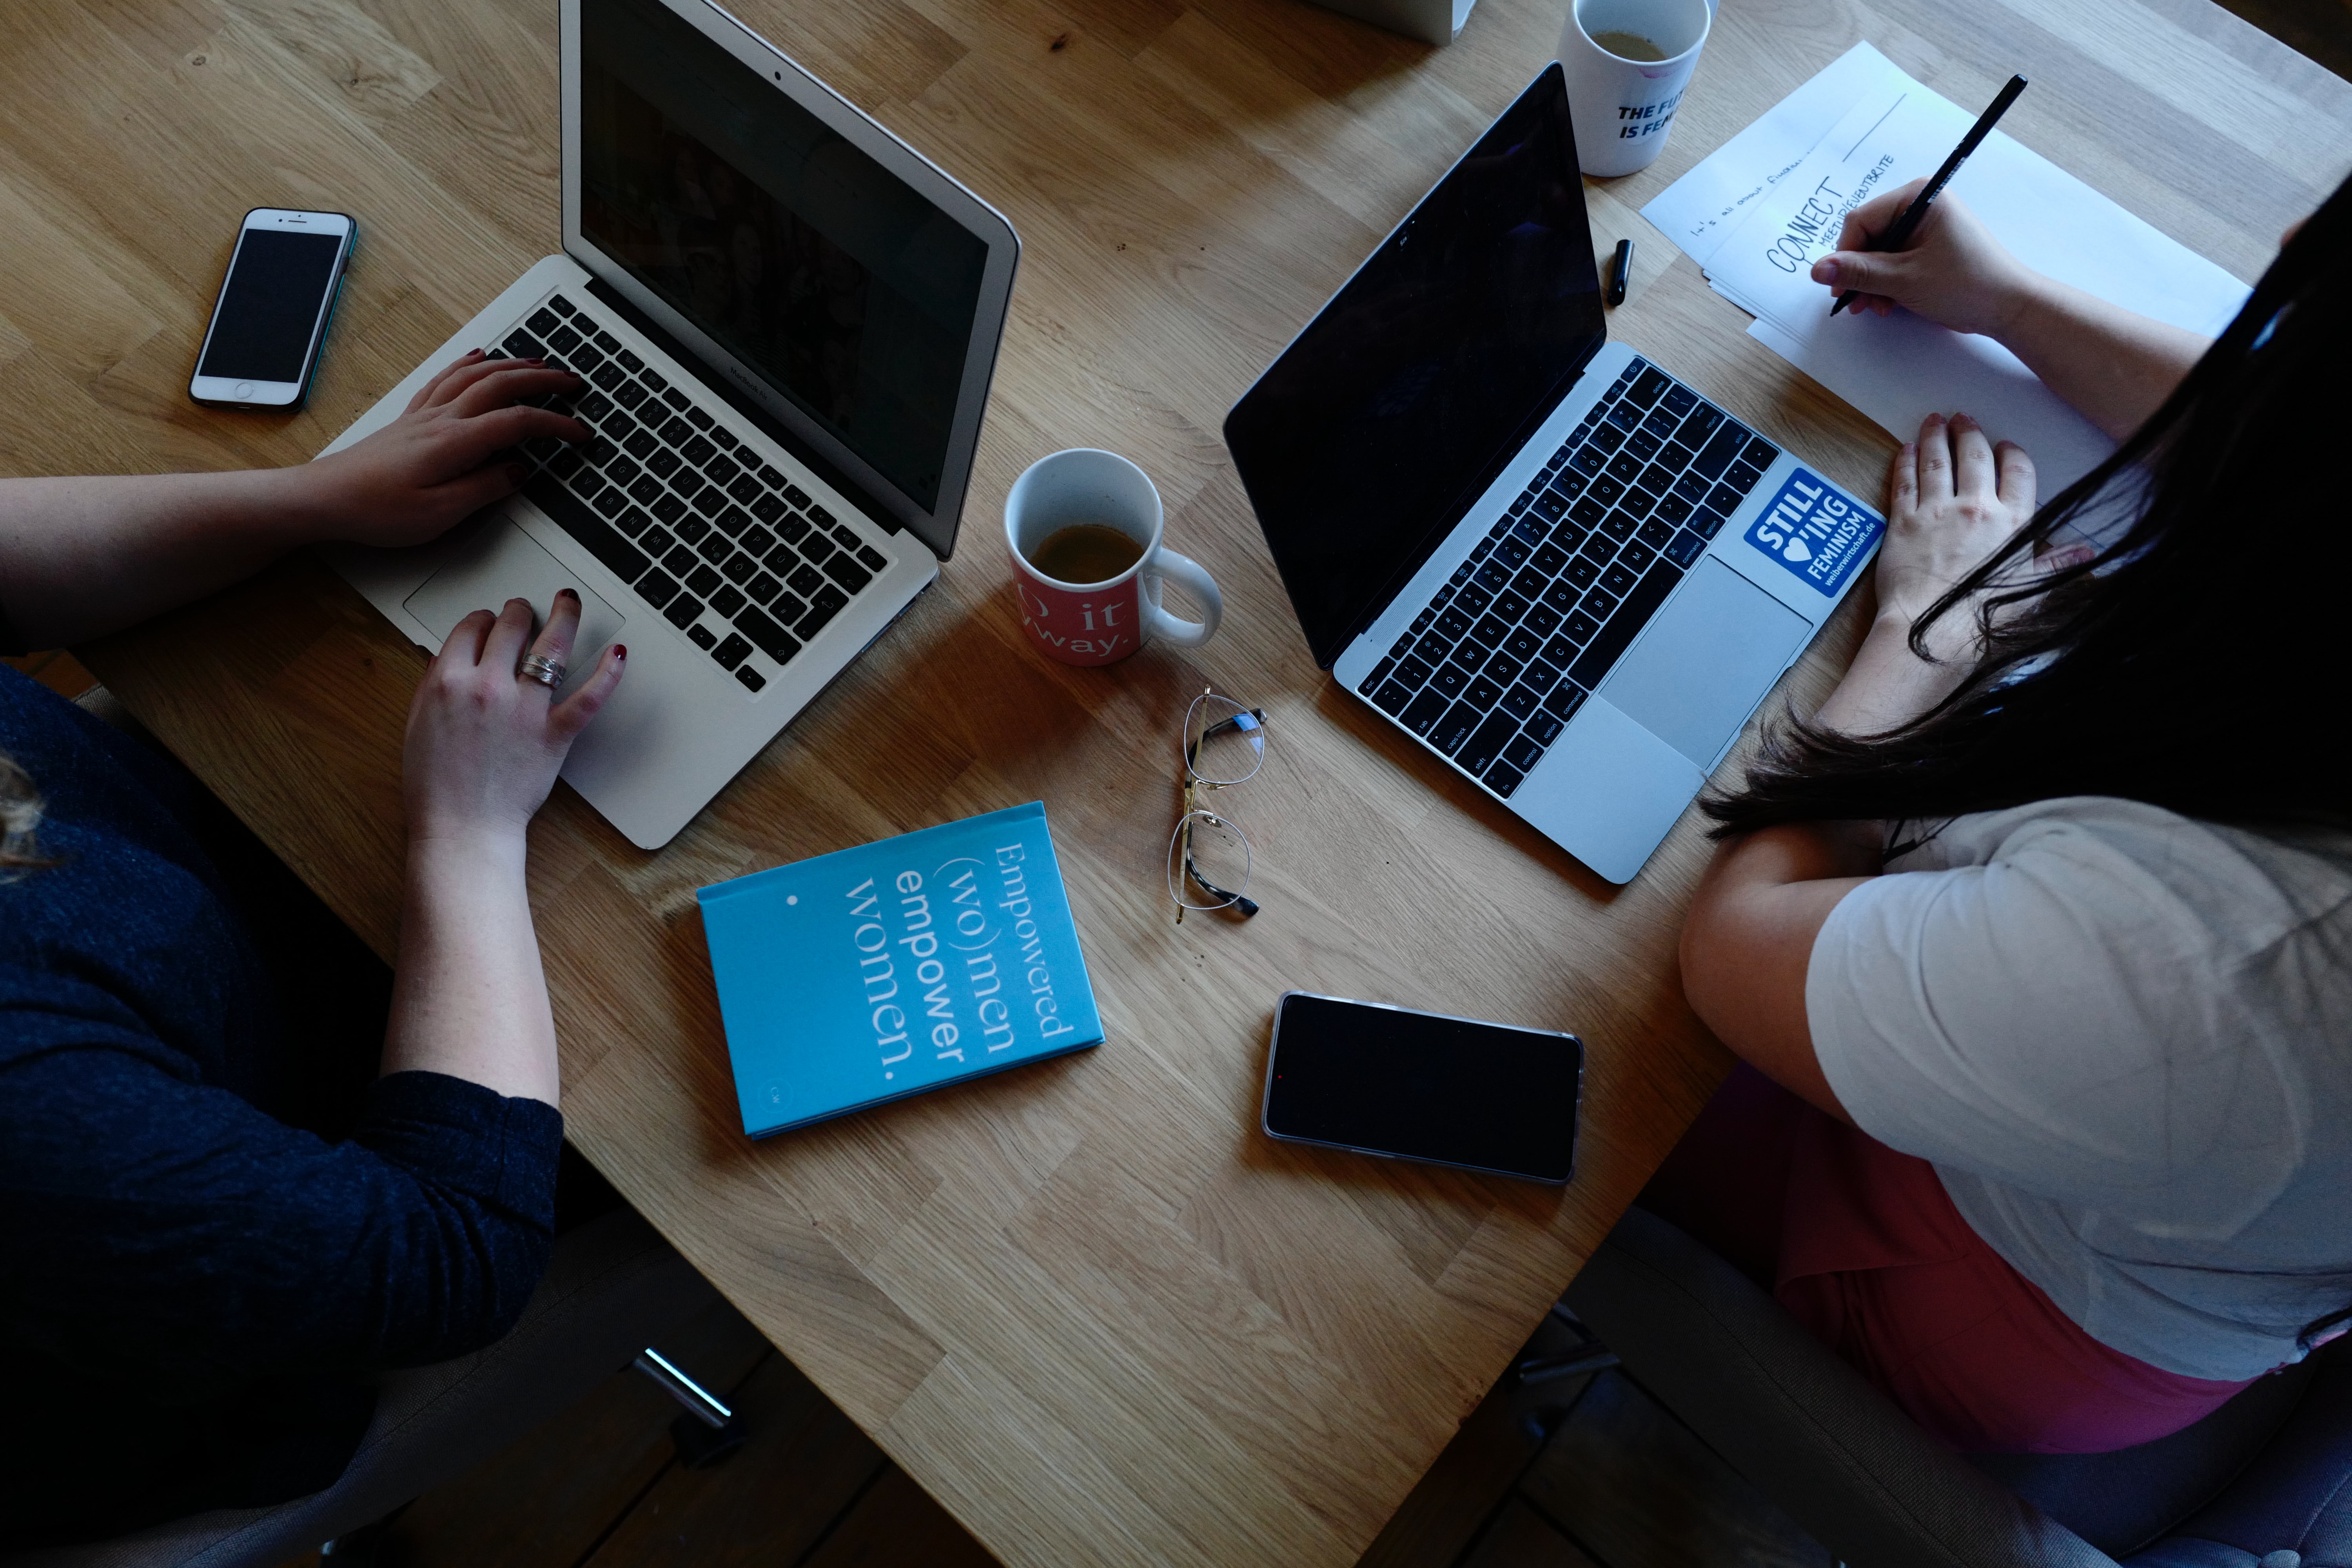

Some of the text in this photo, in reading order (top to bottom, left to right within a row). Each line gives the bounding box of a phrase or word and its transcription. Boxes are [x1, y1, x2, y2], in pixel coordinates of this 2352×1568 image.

[1619, 105, 1656, 120] THE
[1620, 126, 1639, 138] IS
[1722, 207, 1734, 216] all
[1737, 186, 1763, 205] about
[1818, 154, 1894, 246] MEETUP/EVENTBRITE
[1767, 176, 1843, 273] CONNECT
[731, 367, 768, 401] MacBook Air
[1653, 380, 1665, 394] delete
[1706, 416, 1718, 429] return
[1735, 433, 1745, 444] shift
[659, 458, 668, 466] Z
[641, 484, 650, 493] H
[1757, 480, 1823, 550] STILL
[628, 516, 638, 525] N
[1615, 521, 1624, 530] K
[687, 523, 696, 532] K
[1705, 520, 1718, 535] option
[650, 535, 661, 546] M
[1564, 532, 1573, 540] U
[711, 543, 718, 552] L
[1597, 544, 1604, 553] J
[1807, 511, 1866, 580] FEMINISM
[1632, 551, 1642, 561] M
[1682, 541, 1701, 564] command
[1825, 522, 1876, 586] weiberwirtschaft.de
[777, 554, 786, 563] Ü
[735, 562, 744, 571] Ö
[1577, 568, 1586, 577] H
[1493, 575, 1502, 583] 5
[1613, 575, 1623, 584] N
[758, 582, 768, 592] Ä
[650, 593, 662, 604] cmd
[1594, 599, 1604, 608] B
[1506, 603, 1515, 611] R
[1078, 602, 1126, 630] it
[1538, 616, 1546, 624] F
[1486, 627, 1495, 635] E
[1575, 623, 1584, 632] V
[1033, 621, 1128, 657] way.
[1518, 641, 1527, 649] D
[1465, 650, 1475, 660] W
[1555, 648, 1564, 656] C
[1499, 665, 1507, 673] S
[1446, 676, 1456, 684] Q
[1535, 672, 1545, 681] X
[1365, 680, 1375, 690] esc
[1479, 690, 1488, 699] A
[1516, 696, 1526, 706] Z
[1563, 690, 1583, 715] command
[1420, 720, 1428, 730] tab
[1544, 723, 1557, 739] option
[1447, 727, 1467, 749] caps lock
[1523, 747, 1538, 765] control
[1475, 757, 1486, 770] shift
[995, 843, 1074, 1039] Empowered
[933, 857, 1014, 1054] (wo)men
[896, 870, 965, 1062] empower
[845, 877, 913, 1080] women.
